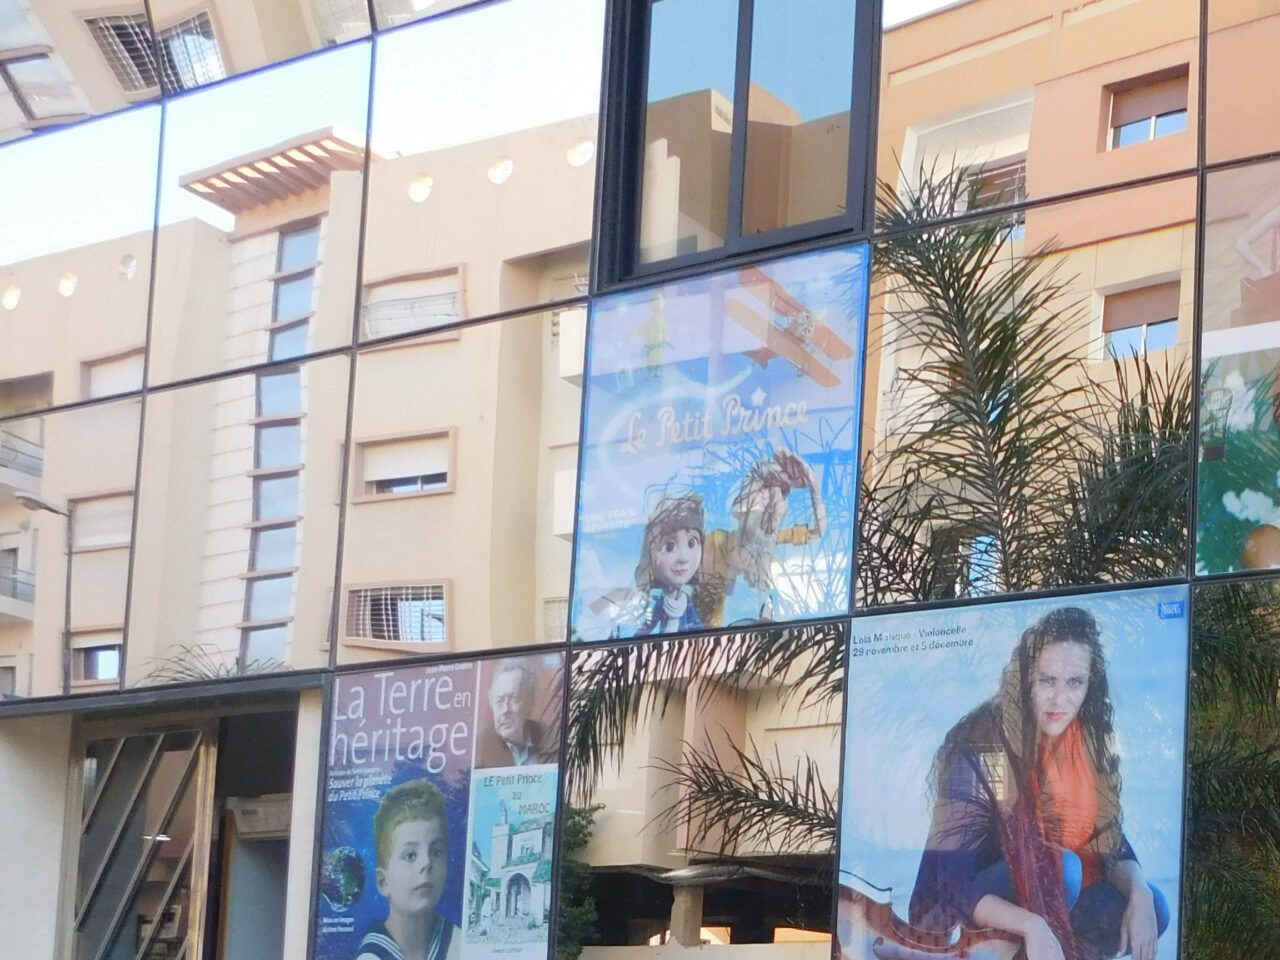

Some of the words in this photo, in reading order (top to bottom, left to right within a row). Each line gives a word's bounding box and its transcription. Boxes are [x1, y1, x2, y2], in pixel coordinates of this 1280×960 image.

[620, 412, 647, 452] Le
[655, 407, 714, 448] Petit
[721, 392, 808, 437] Prince
[334, 678, 365, 720] La
[373, 672, 453, 716] Terre
[453, 691, 471, 708] en
[330, 717, 468, 774] héritage
[518, 802, 551, 816] MAROC
